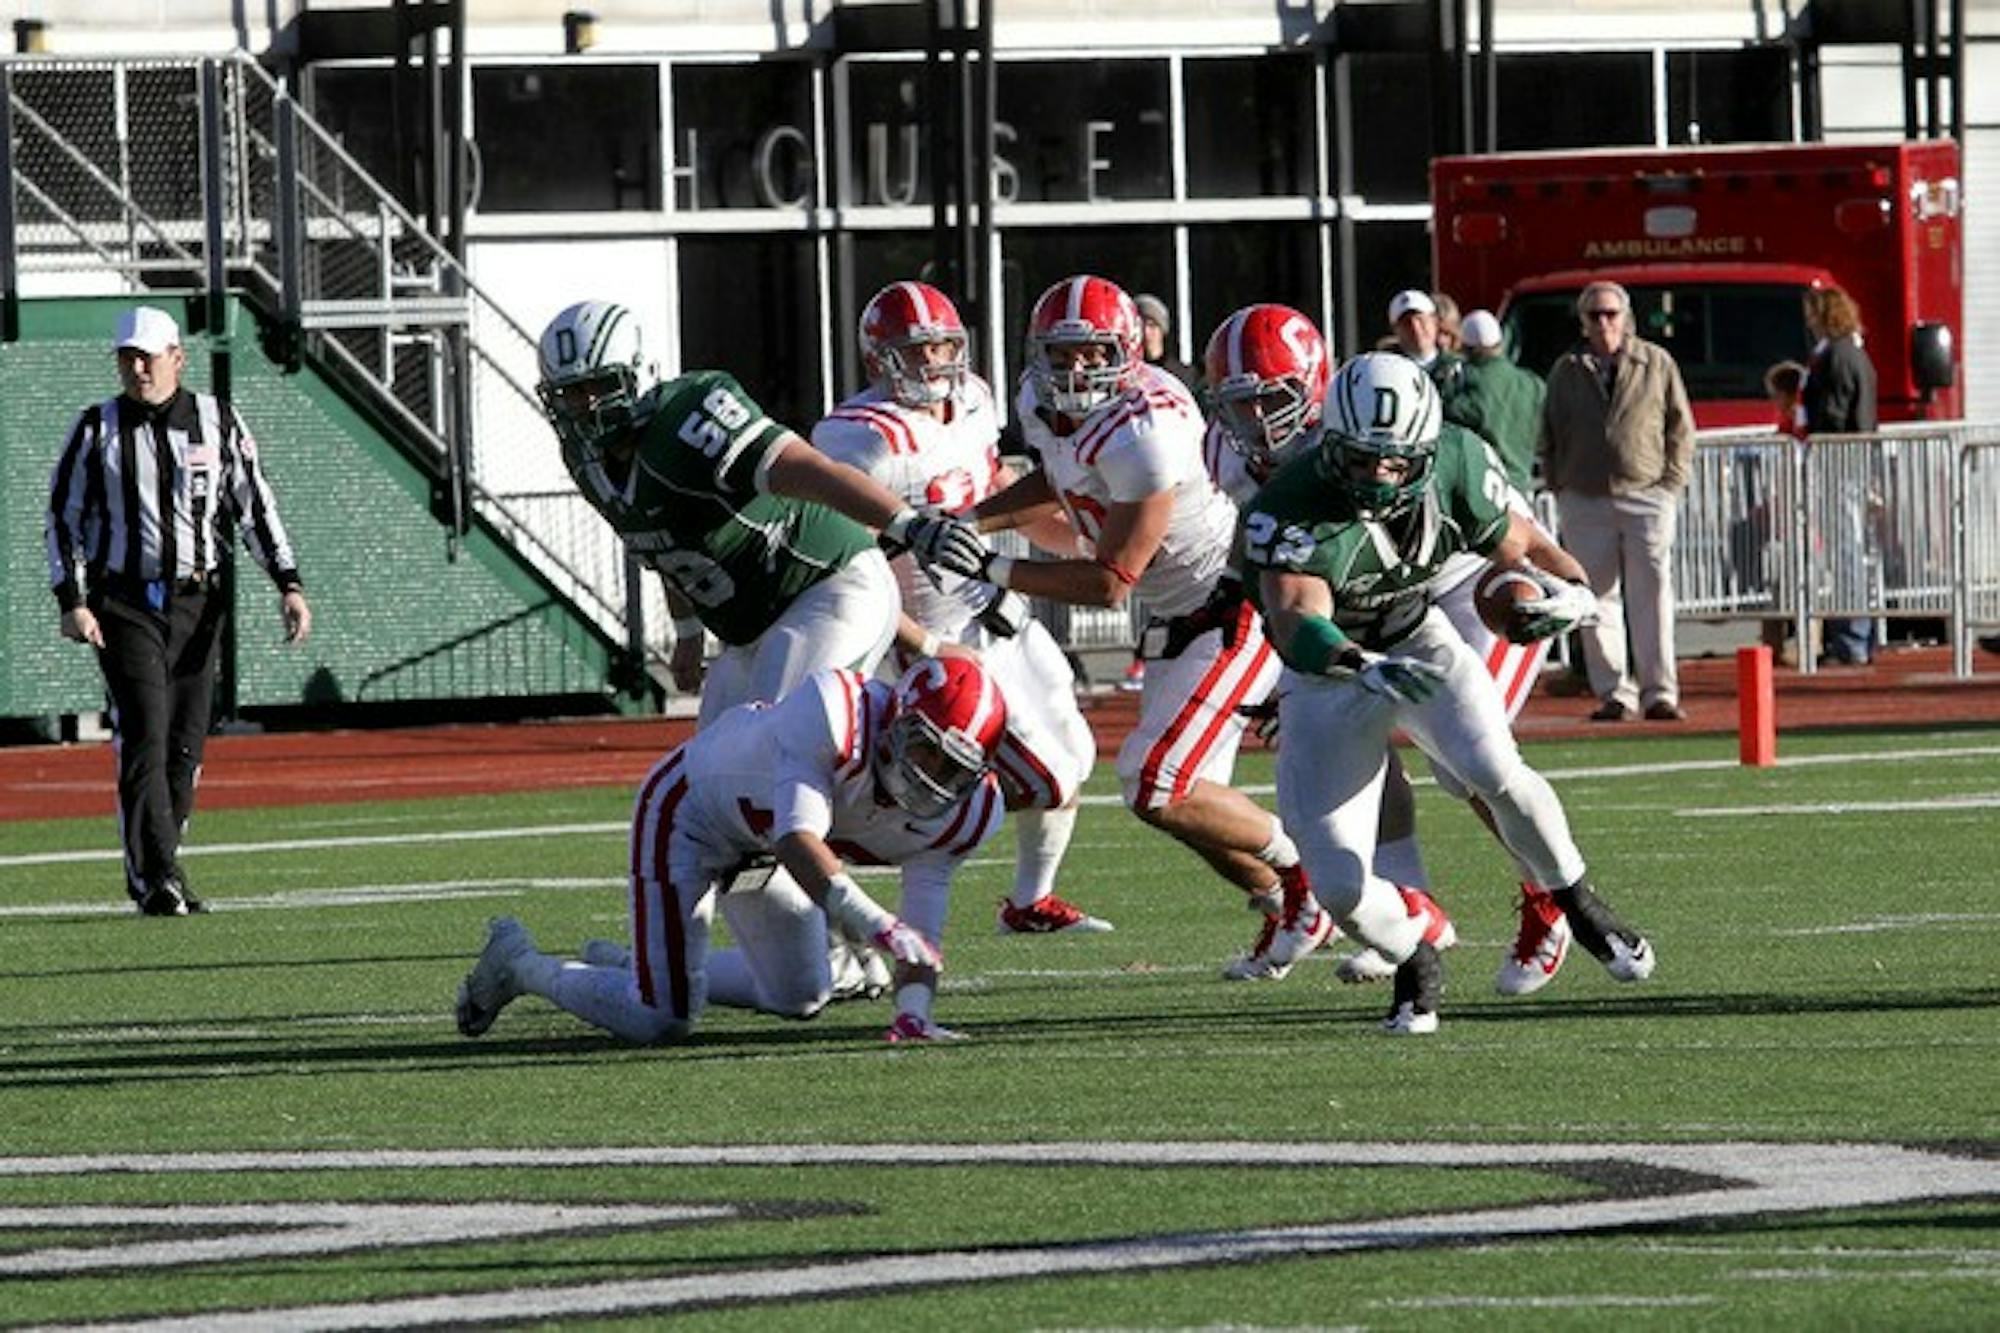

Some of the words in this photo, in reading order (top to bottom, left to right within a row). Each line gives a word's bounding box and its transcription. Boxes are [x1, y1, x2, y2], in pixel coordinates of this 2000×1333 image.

[1583, 236, 1745, 258] AMBULANCE
[1754, 236, 1764, 253] 1
[555, 328, 577, 367] D
[678, 387, 752, 459] 58
[1373, 386, 1398, 429] D
